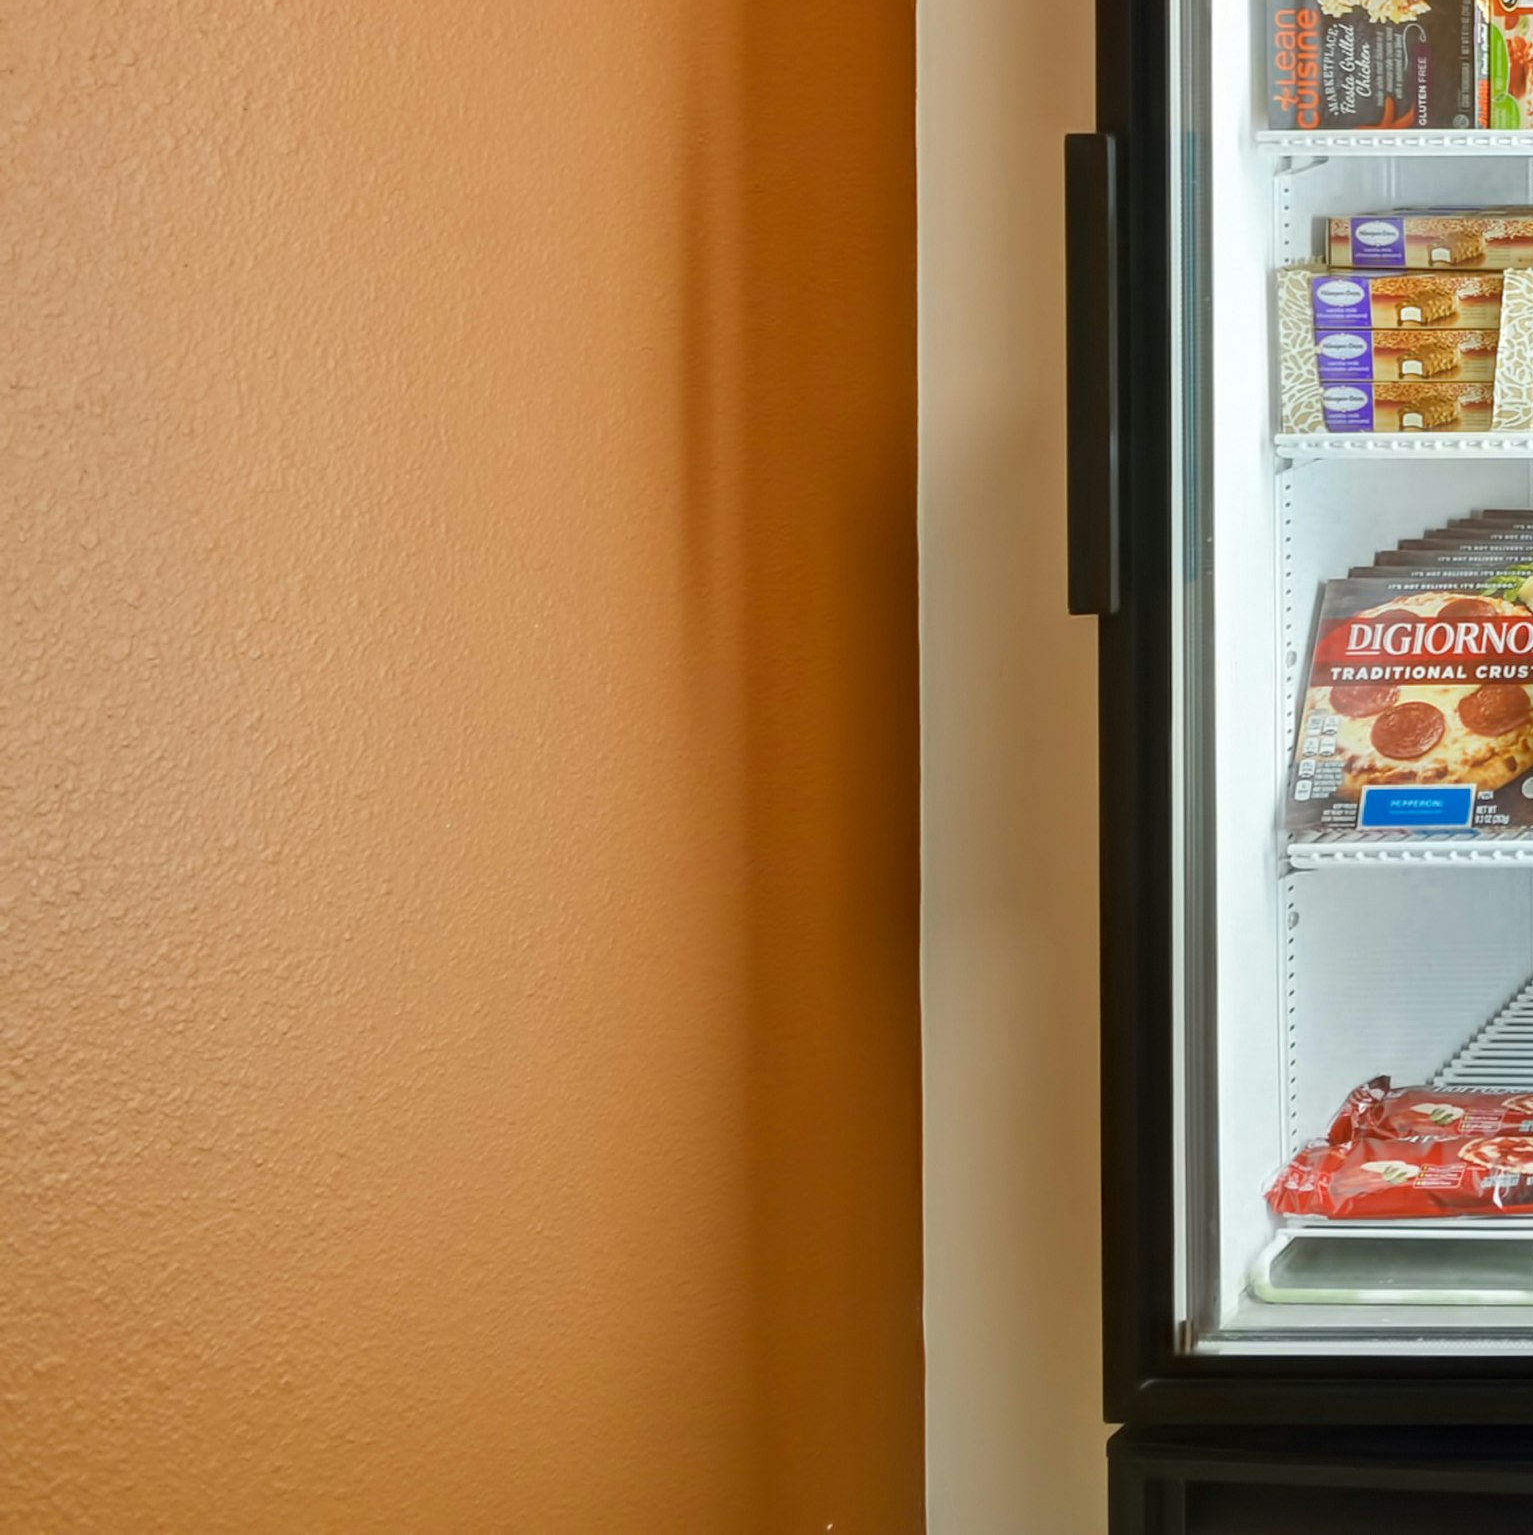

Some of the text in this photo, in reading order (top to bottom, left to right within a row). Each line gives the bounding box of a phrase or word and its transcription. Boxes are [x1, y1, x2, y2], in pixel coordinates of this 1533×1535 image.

[1296, 7, 1321, 130] cuisine
[1322, 27, 1338, 115] MARKETPLACE
[1339, 24, 1356, 115] Fiesta Grilled
[1355, 42, 1371, 98] Chicken
[1418, 56, 1427, 126] GLUTEN FREE
[1330, 665, 1467, 680] TRADITIONAL
